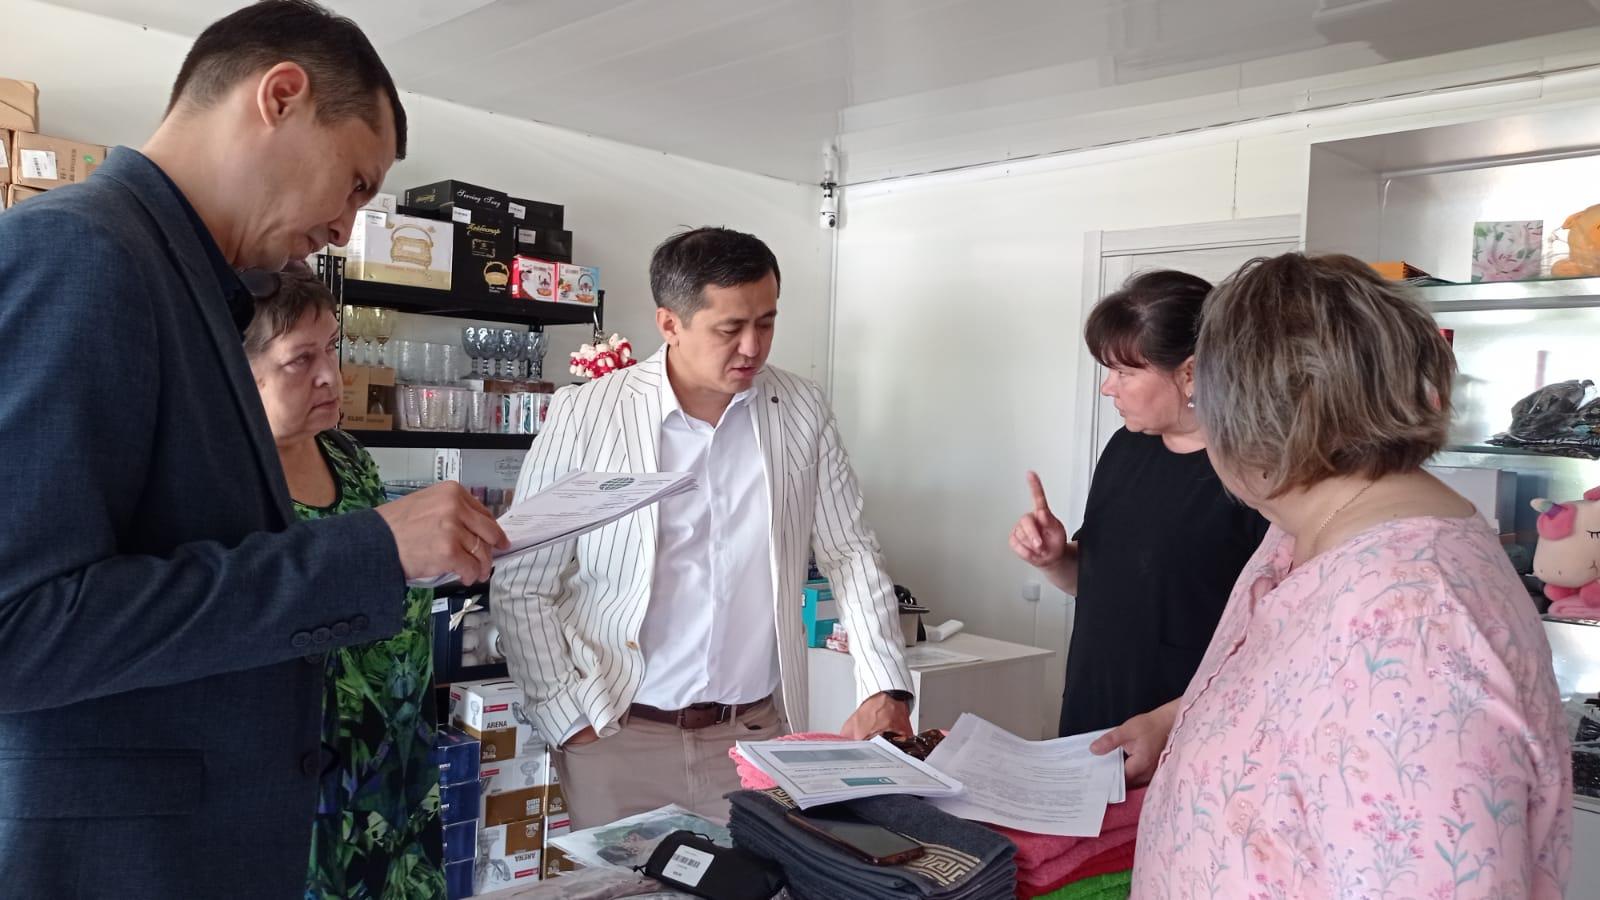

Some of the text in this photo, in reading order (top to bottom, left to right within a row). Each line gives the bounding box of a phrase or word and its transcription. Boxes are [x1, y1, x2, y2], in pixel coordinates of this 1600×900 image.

[456, 189, 501, 208] Serving Tray
[486, 720, 508, 729] ARENA
[514, 852, 536, 862] ARENA
